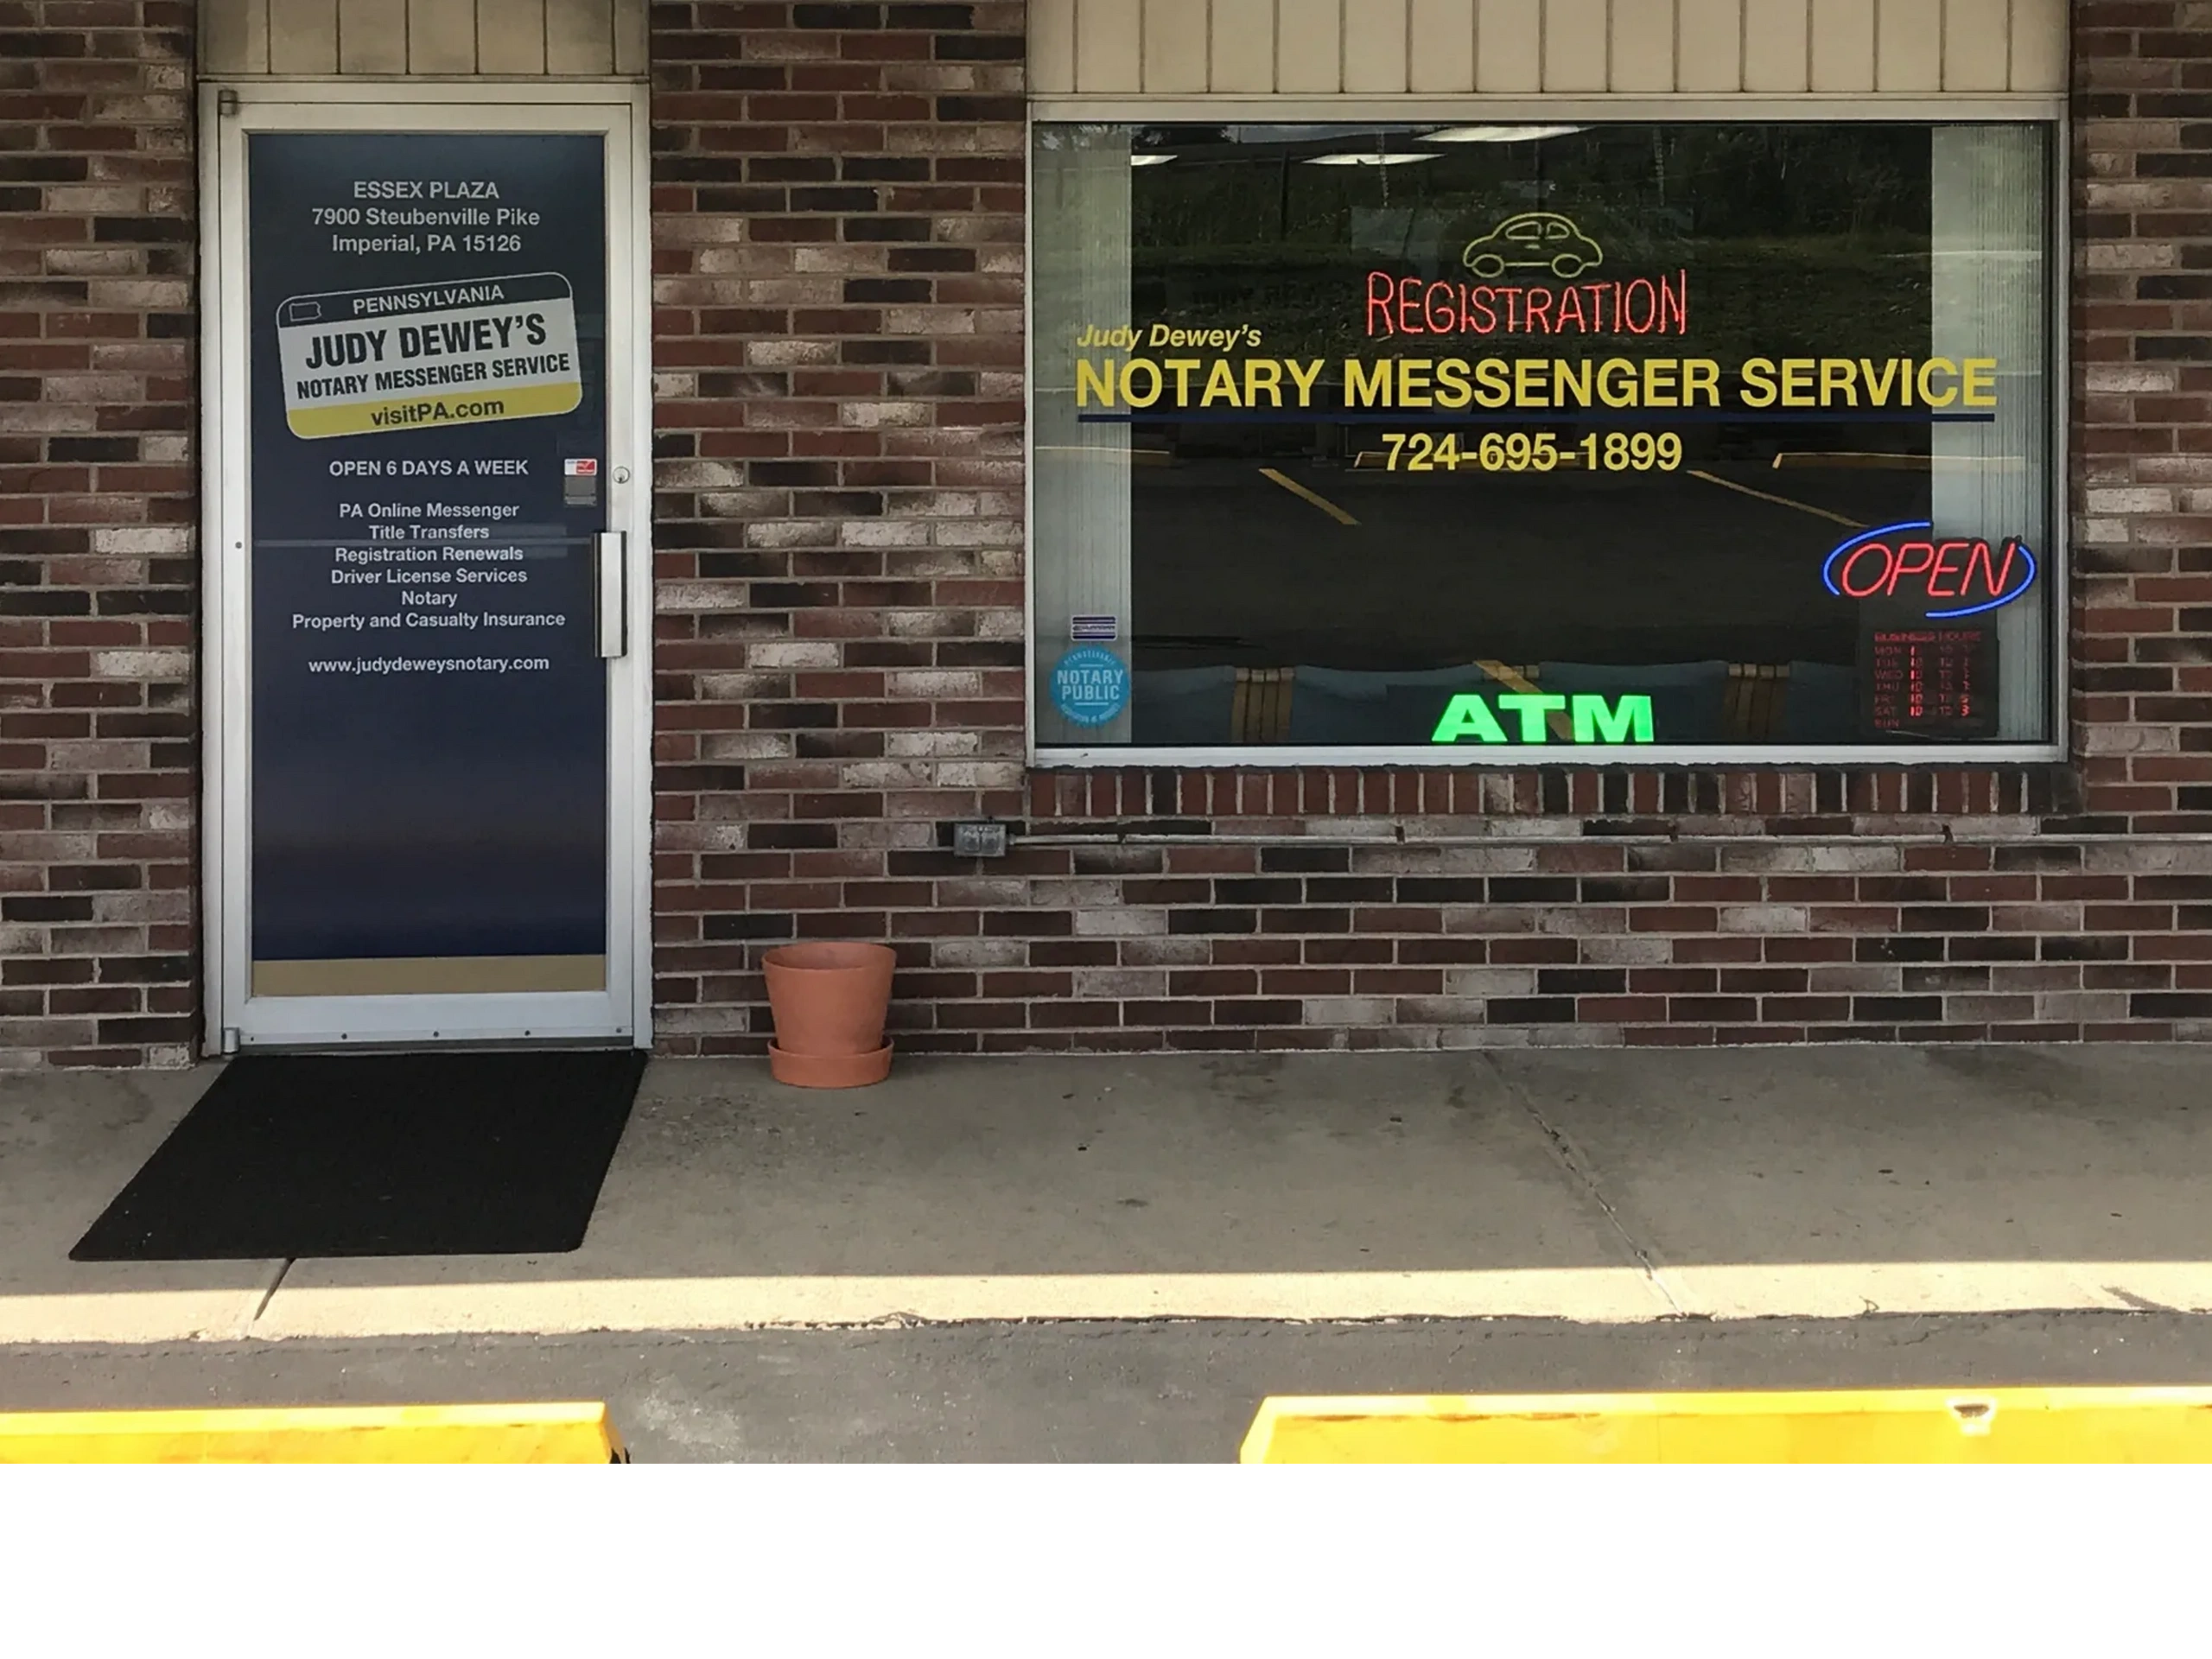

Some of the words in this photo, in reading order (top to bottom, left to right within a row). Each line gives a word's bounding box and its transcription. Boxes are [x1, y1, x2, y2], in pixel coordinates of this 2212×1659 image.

[353, 181, 423, 199] ESSEX
[429, 181, 499, 199] PLAZA
[312, 207, 360, 225] 7900
[365, 207, 490, 226] Steubenville
[497, 207, 540, 226] Pike
[332, 234, 421, 255] Imperial,
[427, 235, 456, 251] PA
[462, 235, 521, 251] 15126
[353, 284, 504, 315] PENNSYLVANIA
[1367, 269, 1686, 335] REGISTRATION
[306, 329, 387, 369] JUDY
[399, 313, 546, 359] DEWEY'S
[1077, 324, 1141, 352] Judy
[1149, 324, 1262, 352] Dewey's
[296, 374, 369, 399] NOTARY
[375, 361, 487, 391] MESSENGER
[493, 353, 570, 378] SERVICE
[1076, 359, 1325, 408] NOTARY
[1344, 358, 1720, 408] MESSENGER
[1739, 358, 1998, 408] SERVICE
[371, 400, 504, 426] visitPA.com
[1381, 432, 1682, 472] 724-695-1899
[329, 461, 381, 476] OPEN
[385, 461, 397, 475] 6
[402, 460, 452, 476] DAYS
[456, 460, 470, 475] A
[474, 460, 529, 475] WEEK
[339, 503, 363, 518] PA
[368, 503, 422, 518] Online
[426, 503, 520, 520] Messenger
[369, 524, 405, 539] Title
[410, 524, 490, 539] Transfers
[335, 546, 437, 565] Registration
[442, 545, 524, 562] Renewals
[331, 569, 382, 584] Driver
[386, 569, 451, 583] License
[455, 568, 528, 583] Services
[1841, 542, 2016, 596] OPEN
[401, 590, 458, 608] Notary
[292, 613, 365, 632] Property
[369, 613, 401, 628] and
[405, 612, 479, 630] Casualty
[483, 612, 566, 627] Insurance
[308, 656, 550, 675] www.judydeweysnotary.com
[1057, 669, 1123, 685] NOTARY
[1061, 685, 1120, 701] PUBLIC
[1431, 694, 1655, 742] ATM
